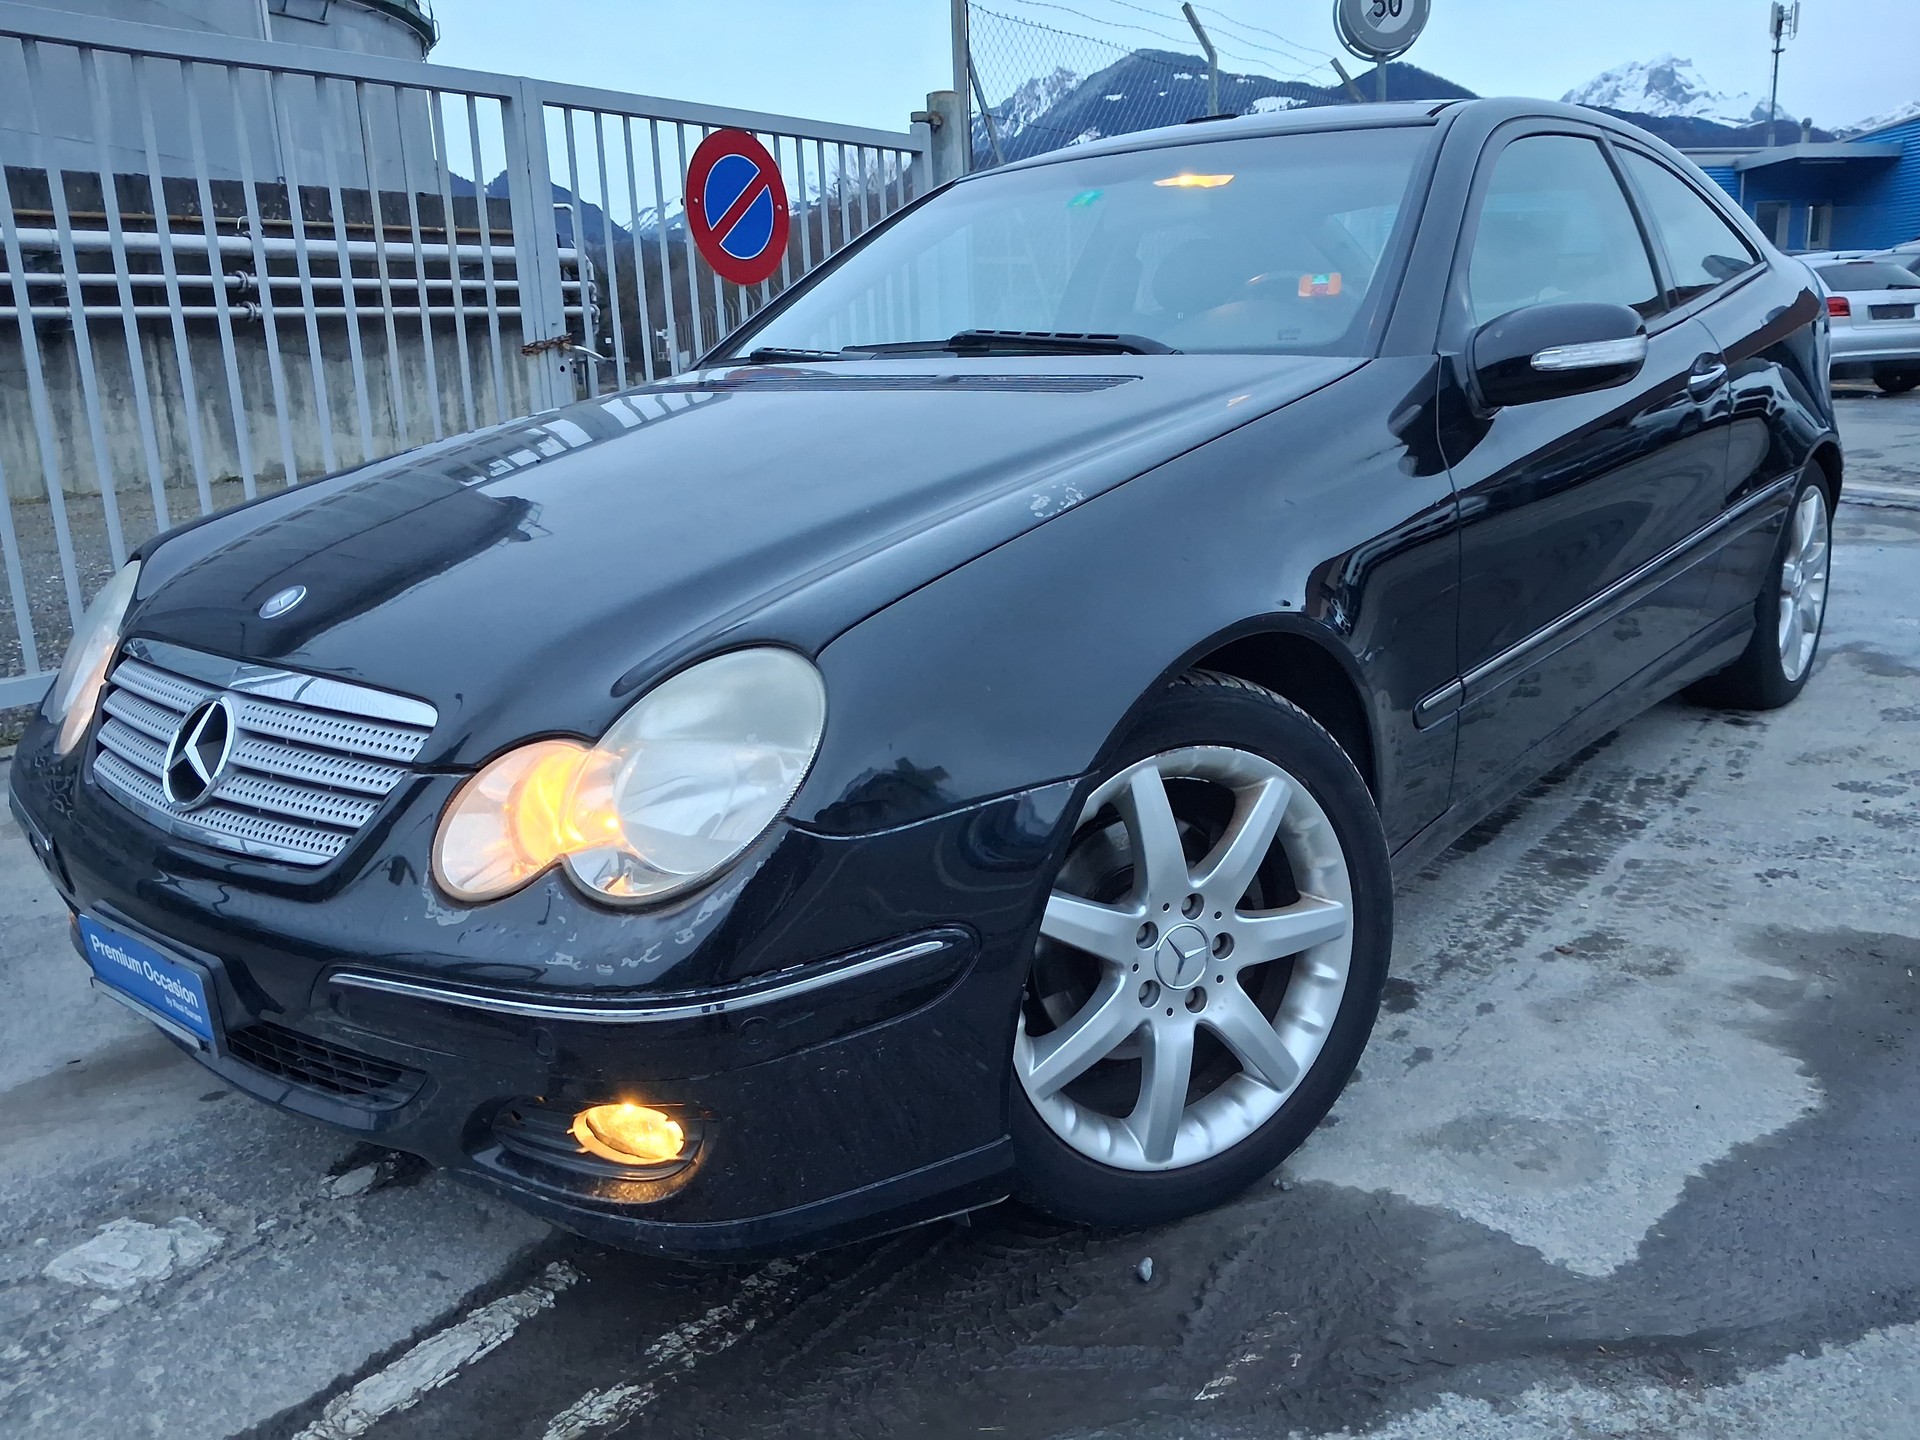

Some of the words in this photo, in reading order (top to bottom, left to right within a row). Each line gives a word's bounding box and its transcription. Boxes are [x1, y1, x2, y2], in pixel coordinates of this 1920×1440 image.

[1372, 0, 1402, 17] 50
[90, 933, 143, 976] Premium
[143, 960, 199, 1008] Occasion
